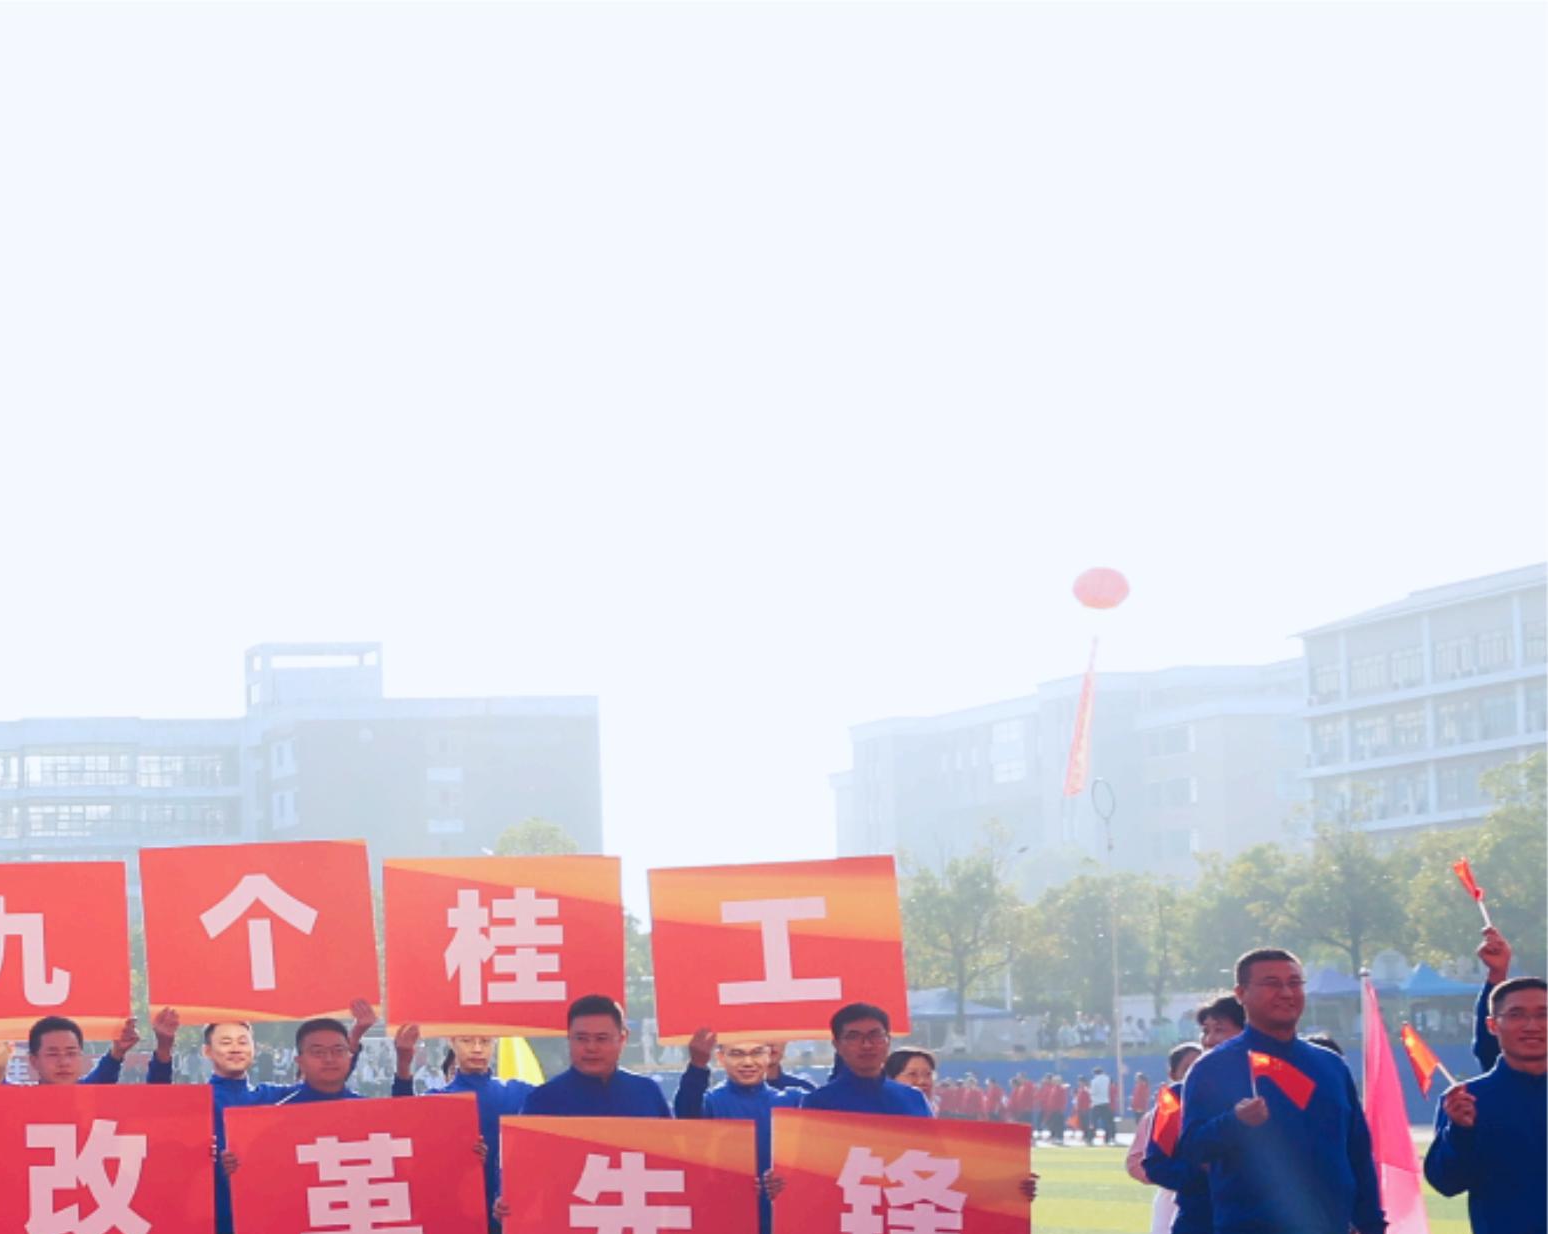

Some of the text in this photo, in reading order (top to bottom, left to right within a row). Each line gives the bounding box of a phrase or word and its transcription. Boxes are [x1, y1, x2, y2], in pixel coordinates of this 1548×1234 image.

[199, 873, 319, 990] 个
[444, 886, 567, 1005] 桂
[718, 895, 842, 1005] 工
